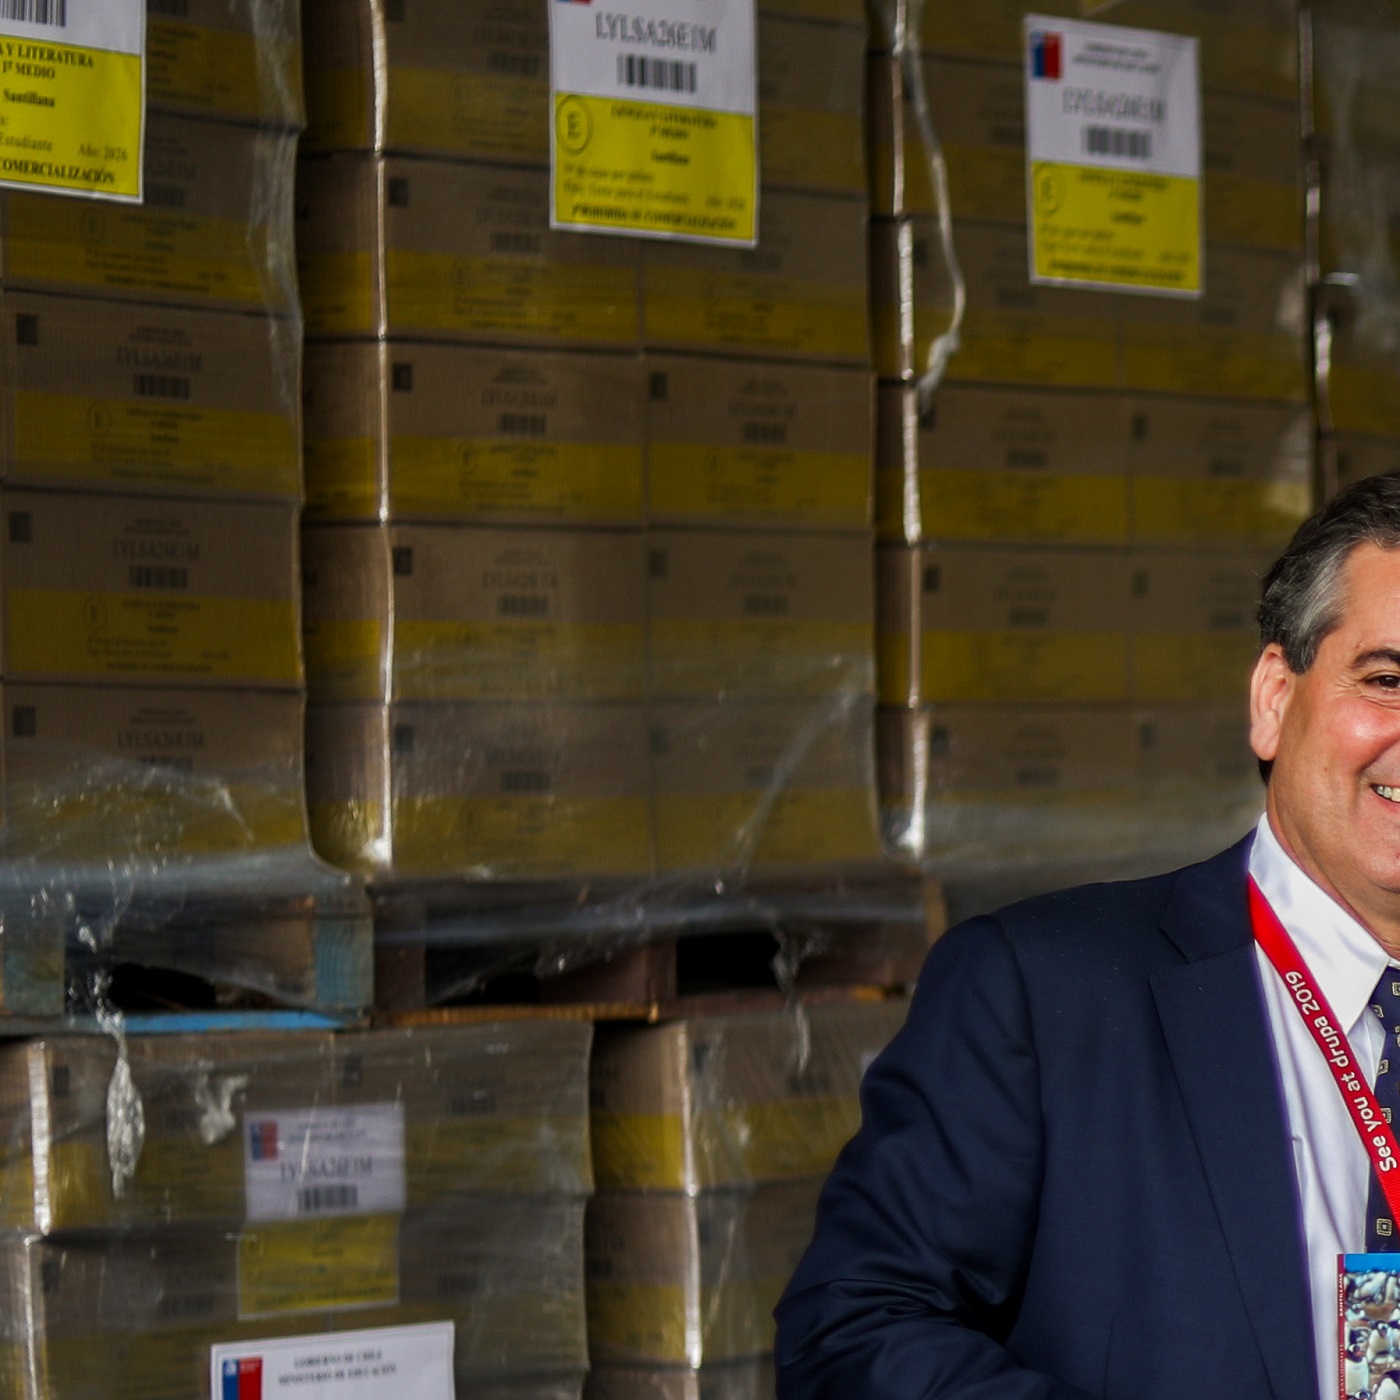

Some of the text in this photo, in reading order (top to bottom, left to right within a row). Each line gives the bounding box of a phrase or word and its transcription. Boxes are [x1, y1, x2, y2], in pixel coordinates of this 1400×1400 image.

[17, 45, 95, 68] LITERATURA
[15, 63, 56, 79] MEDIO
[3, 88, 56, 108] Santillana
[1284, 970, 1398, 1173] See you at drupa 2019
